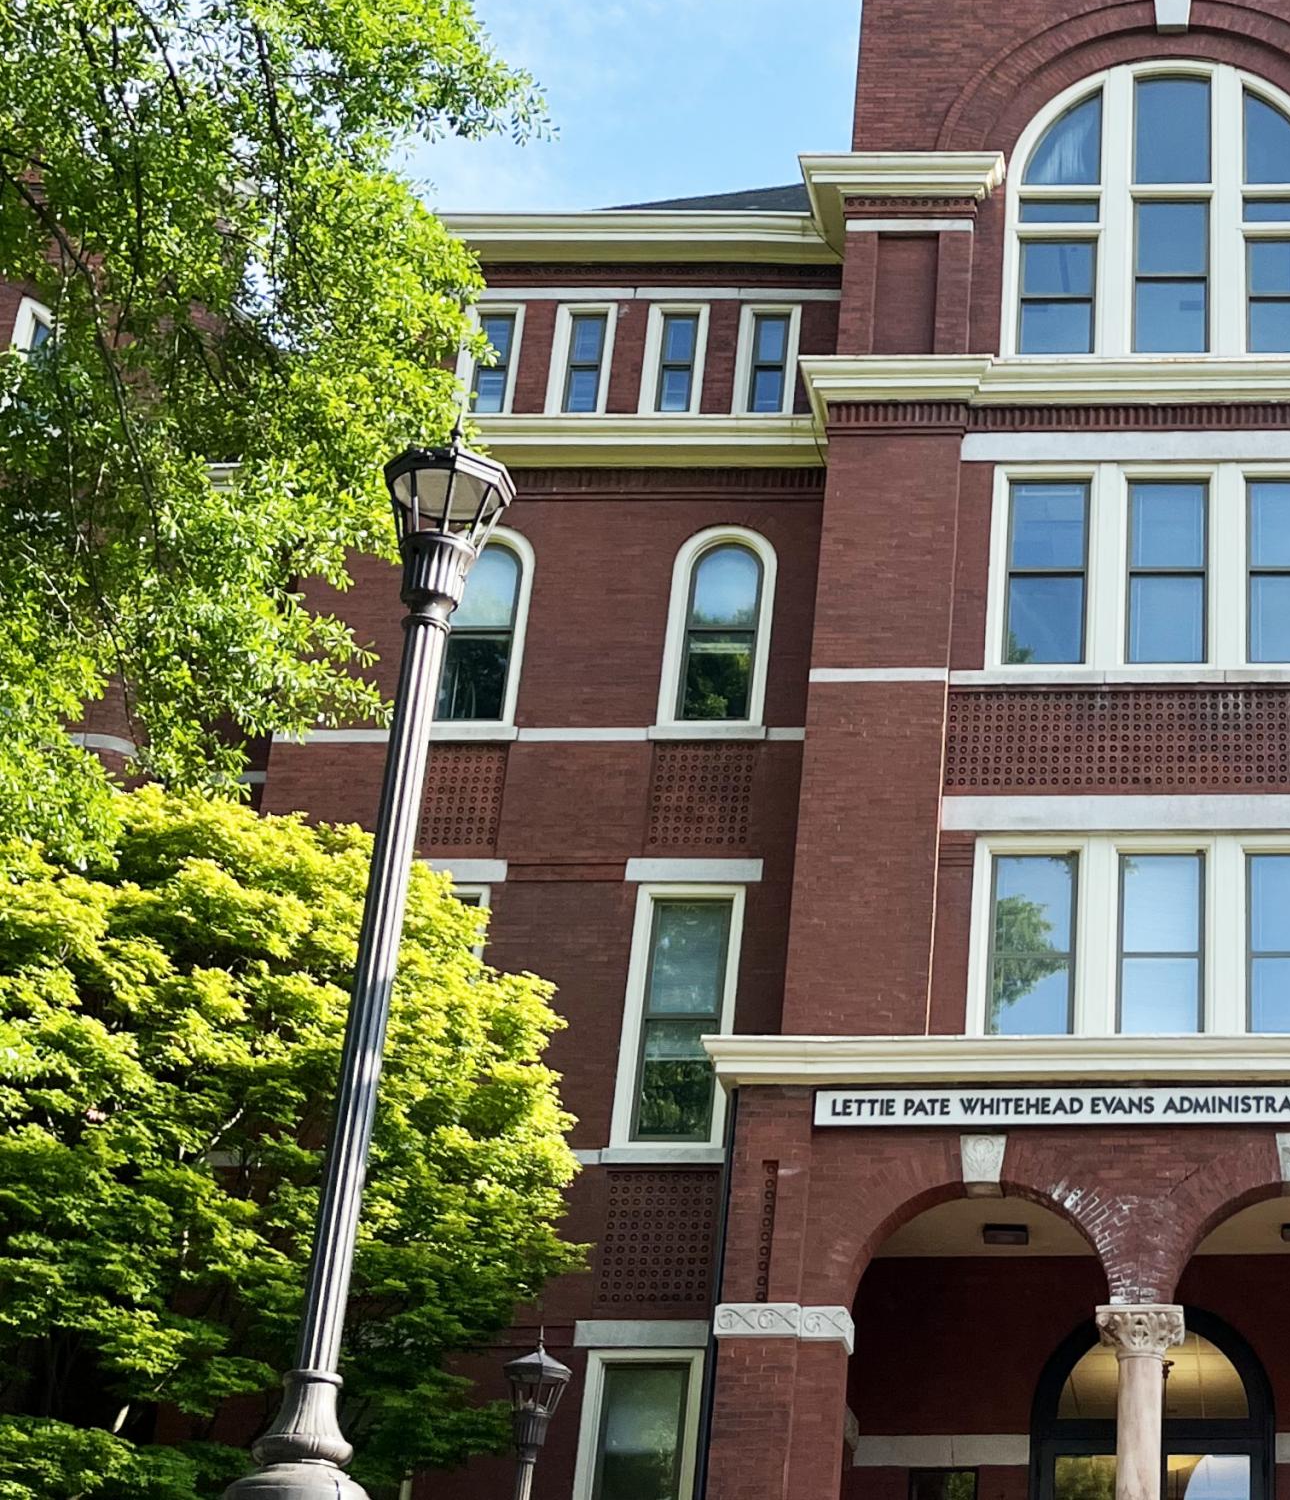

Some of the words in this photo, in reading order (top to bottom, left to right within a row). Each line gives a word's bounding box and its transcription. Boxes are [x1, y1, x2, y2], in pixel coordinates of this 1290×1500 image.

[831, 1098, 896, 1117] LETTIE
[903, 1098, 951, 1116] PATE
[959, 1097, 1084, 1116] WHITEHEAD
[1090, 1096, 1155, 1115] EVANS
